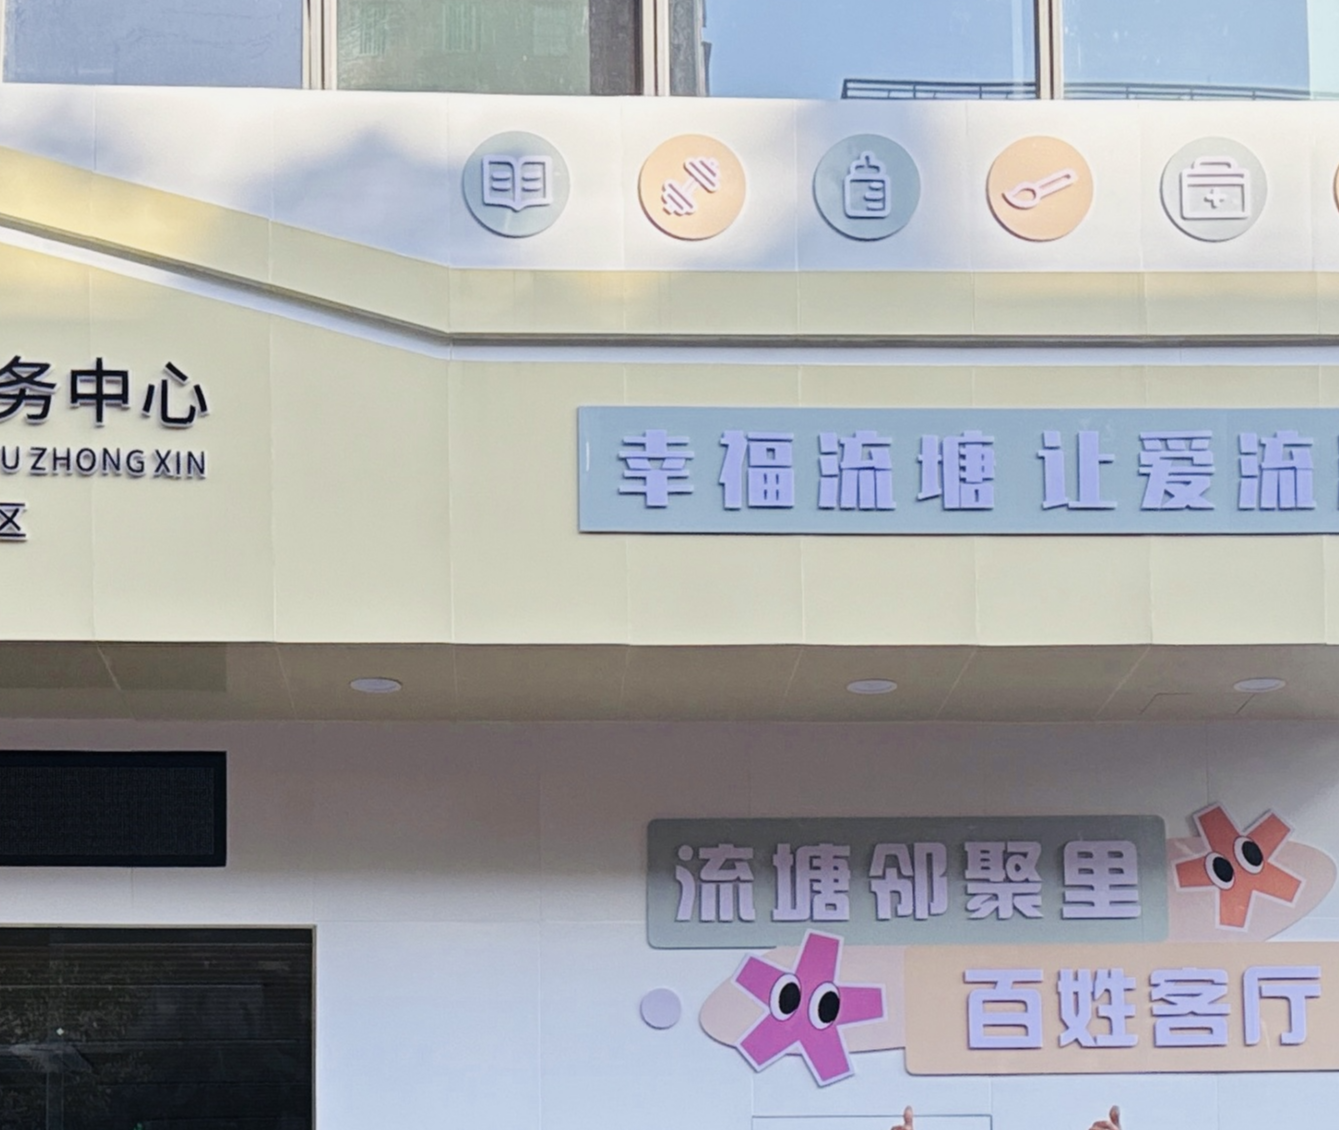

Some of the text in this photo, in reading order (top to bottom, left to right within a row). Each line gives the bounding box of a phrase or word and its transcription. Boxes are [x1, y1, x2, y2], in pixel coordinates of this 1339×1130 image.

[30, 447, 146, 477] ZHONG
[154, 449, 206, 478] XIN
[617, 429, 997, 511] 幸福流塘
[673, 839, 1143, 924] 流塘邻聚里
[964, 965, 1323, 1050] 百姓客厅
